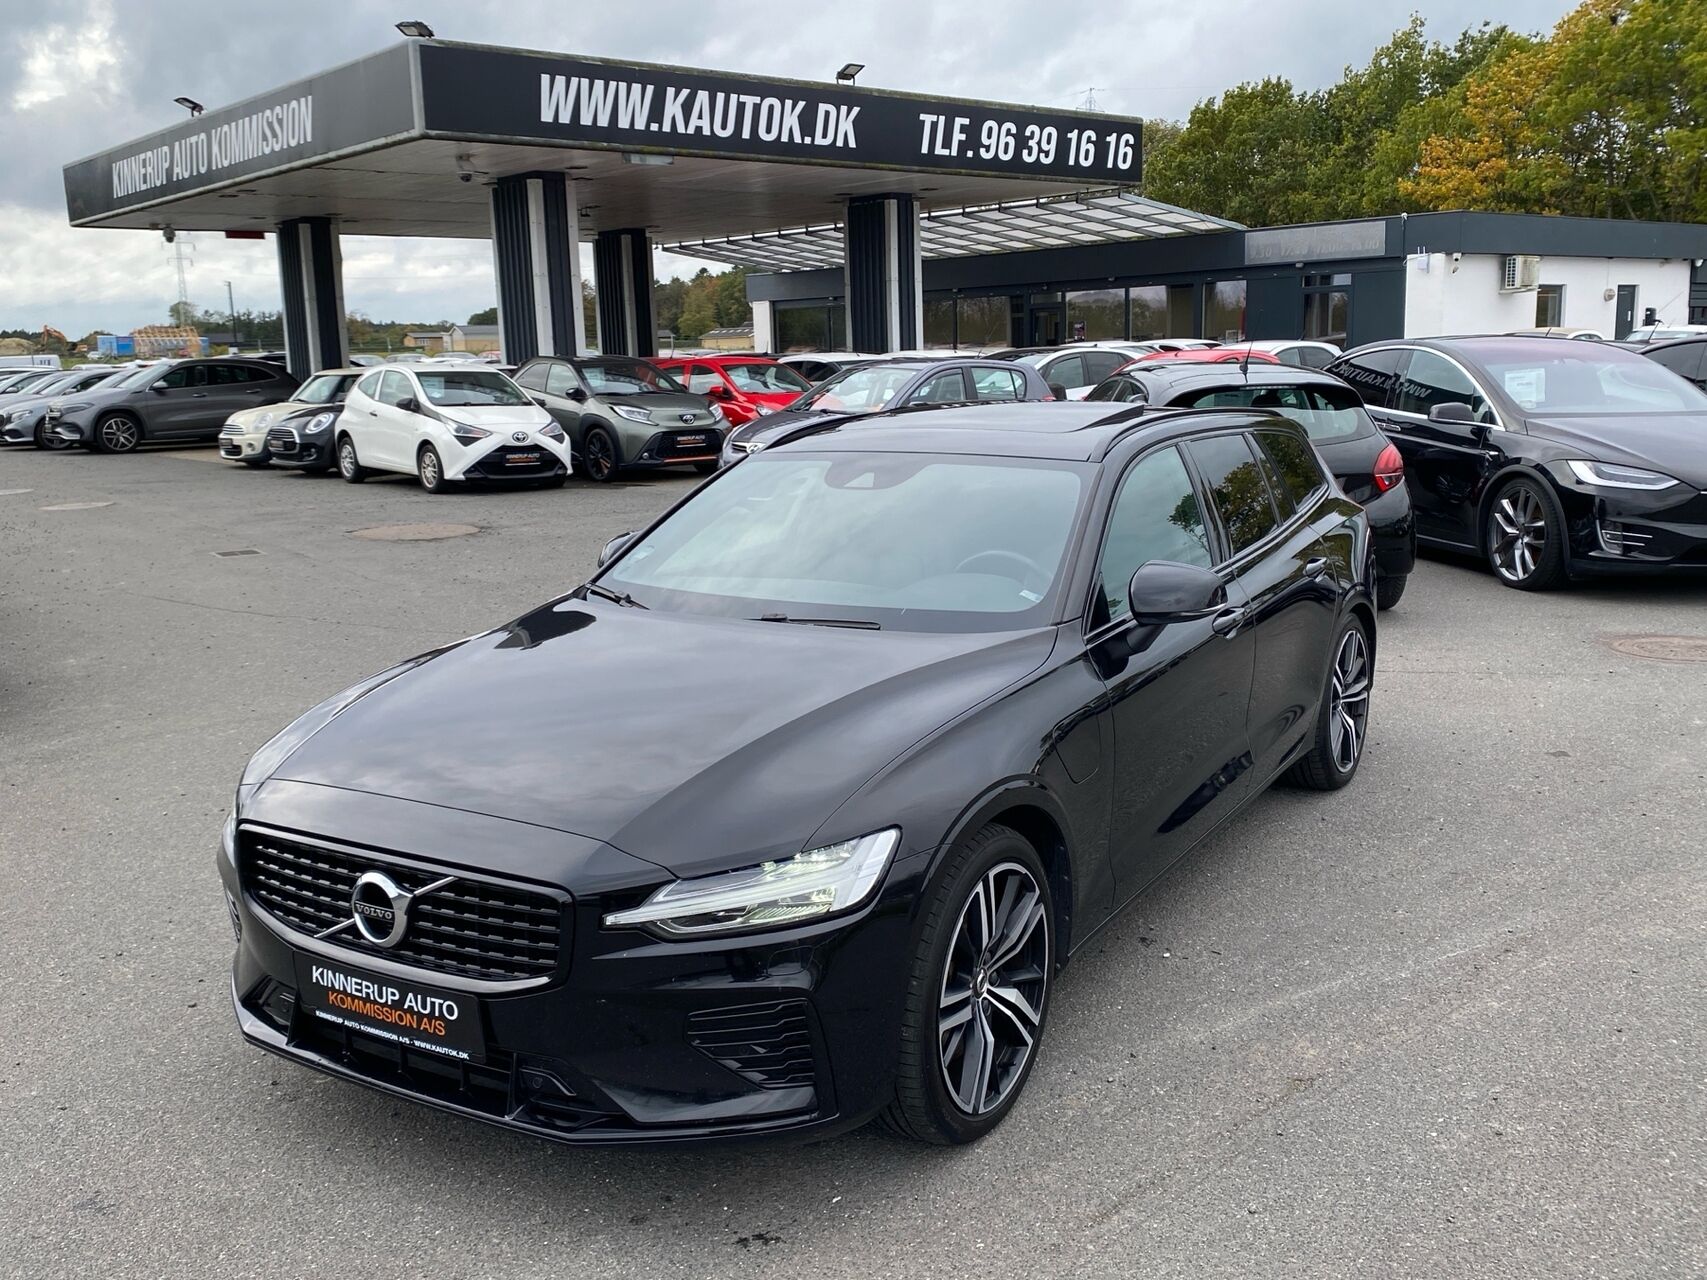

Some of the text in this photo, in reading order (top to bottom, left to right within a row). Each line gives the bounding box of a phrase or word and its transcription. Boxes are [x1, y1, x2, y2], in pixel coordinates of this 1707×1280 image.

[540, 73, 861, 149] WWW.KAUTOK.DK
[112, 95, 312, 199] KINNERUP AUTO KOMMISSION
[919, 113, 1135, 170] TLF. 96 39 16 16
[356, 904, 392, 919] VOLVO
[312, 965, 458, 1020] KINNERUP AUTO
[328, 990, 446, 1036] KOMMISSION A/S
[344, 1019, 360, 1031] AUTO
